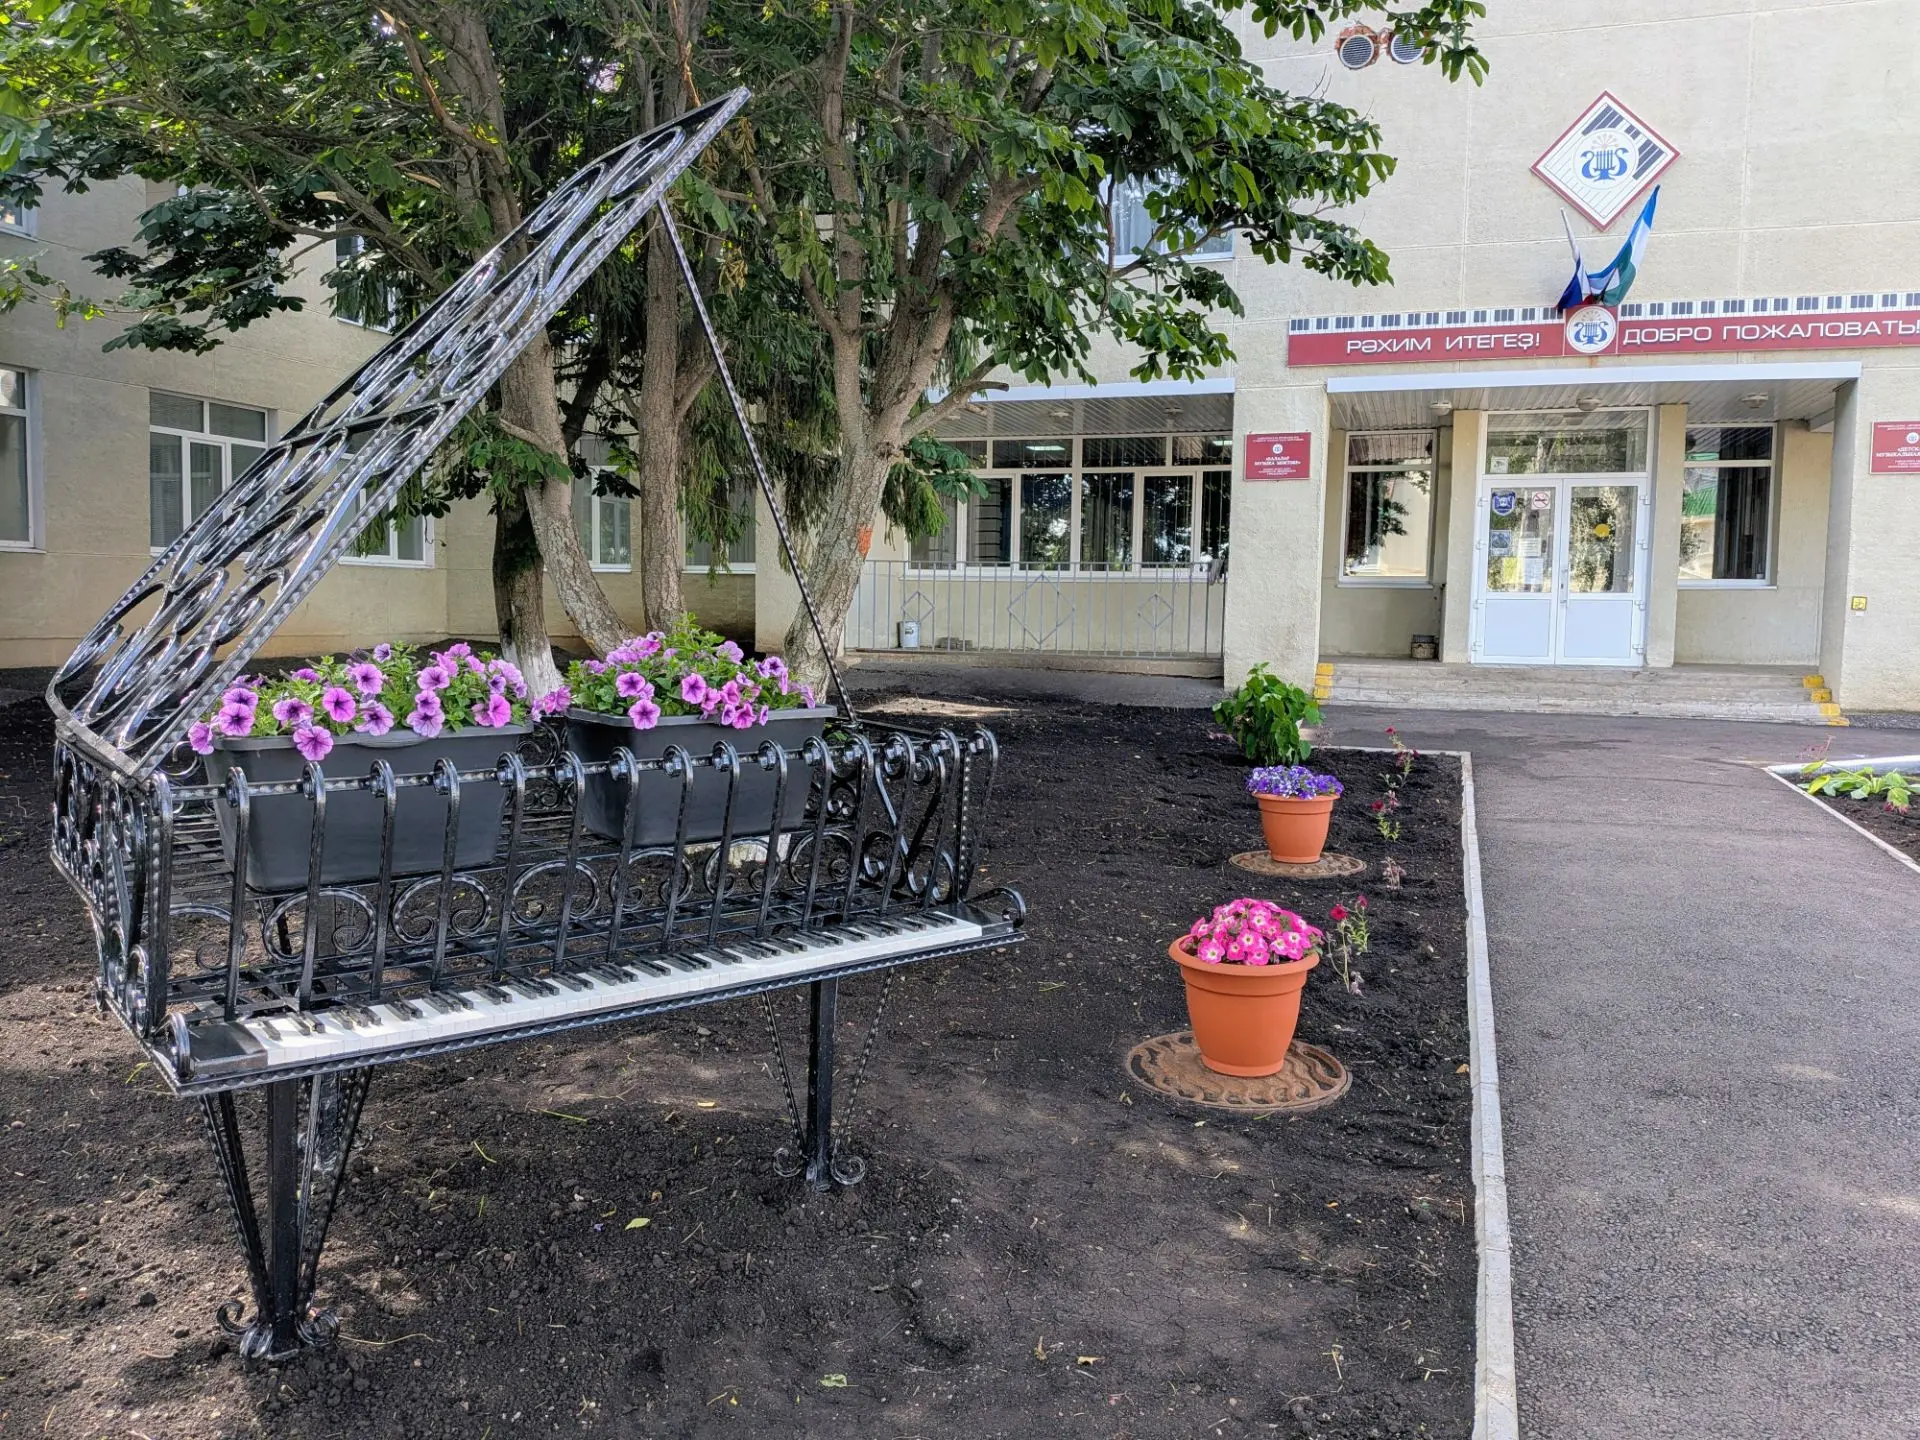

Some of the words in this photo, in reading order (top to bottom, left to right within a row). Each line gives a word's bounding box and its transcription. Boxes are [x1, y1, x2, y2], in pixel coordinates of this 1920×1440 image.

[1622, 327, 1712, 346] ДОБРО
[1722, 319, 1920, 341] ПОЖАЛОВАТЬ!
[1347, 337, 1432, 354] РӘХИМ
